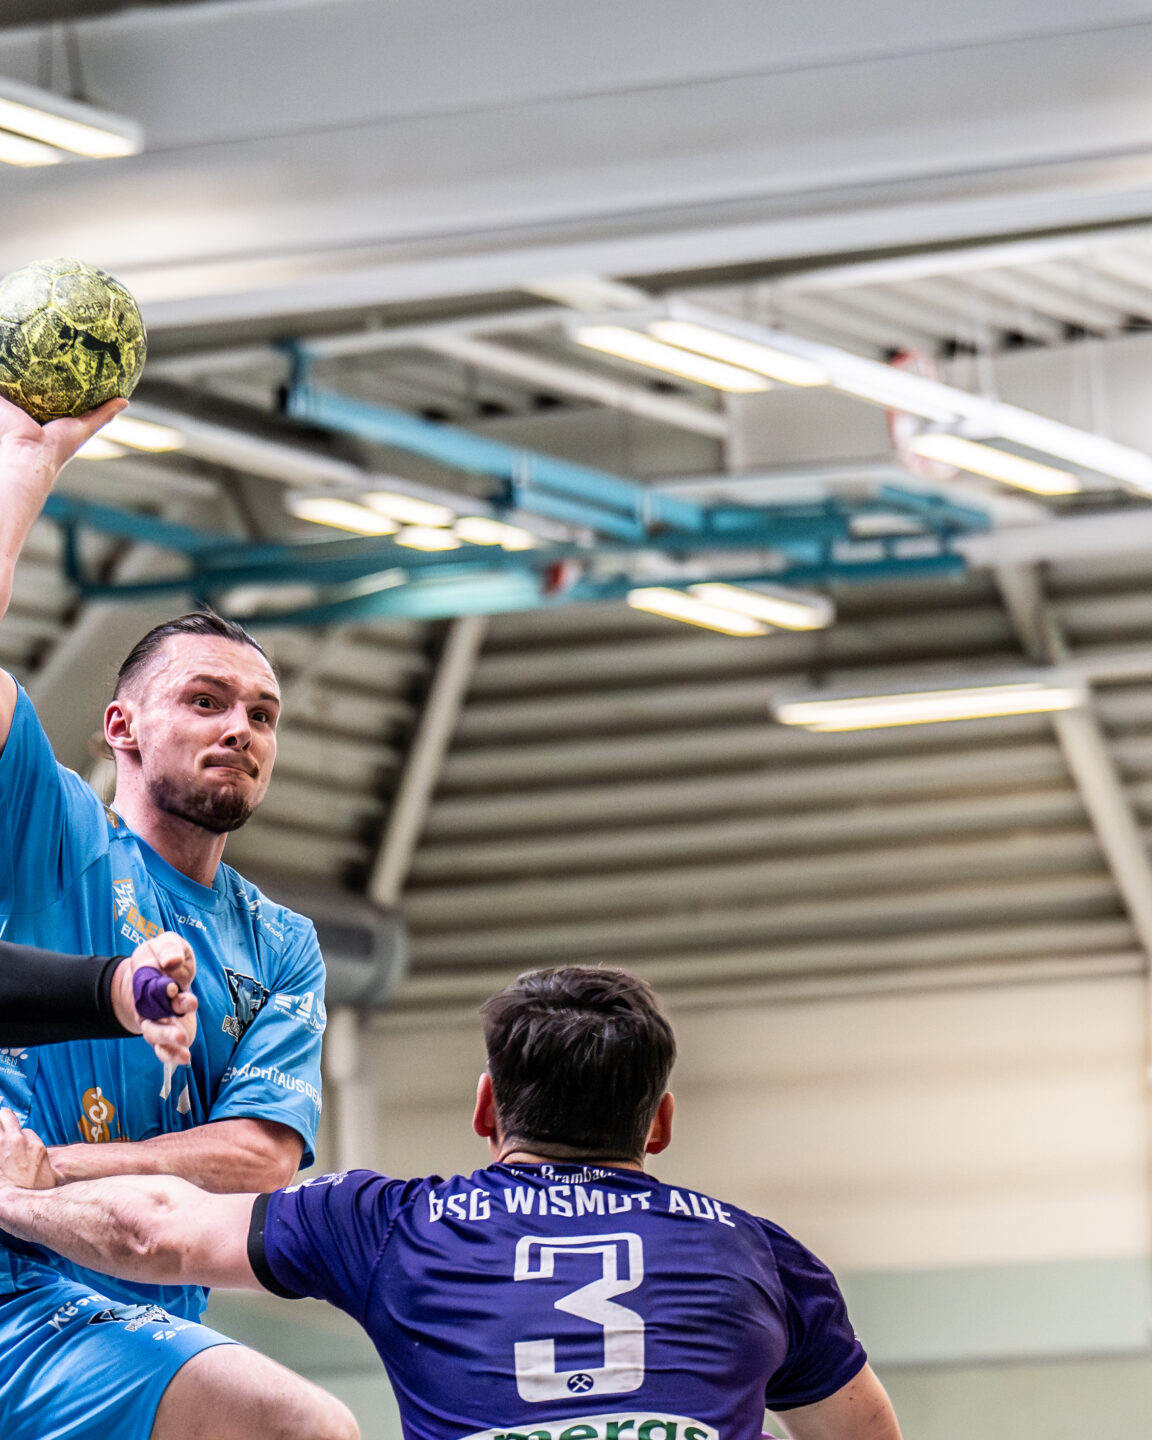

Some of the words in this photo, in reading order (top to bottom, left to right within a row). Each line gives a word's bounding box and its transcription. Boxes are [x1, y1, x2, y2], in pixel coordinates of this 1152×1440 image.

[429, 1188, 490, 1223] BSG
[503, 1185, 652, 1218] WISMUT
[668, 1190, 736, 1228] AUE
[514, 1232, 645, 1402] 3
